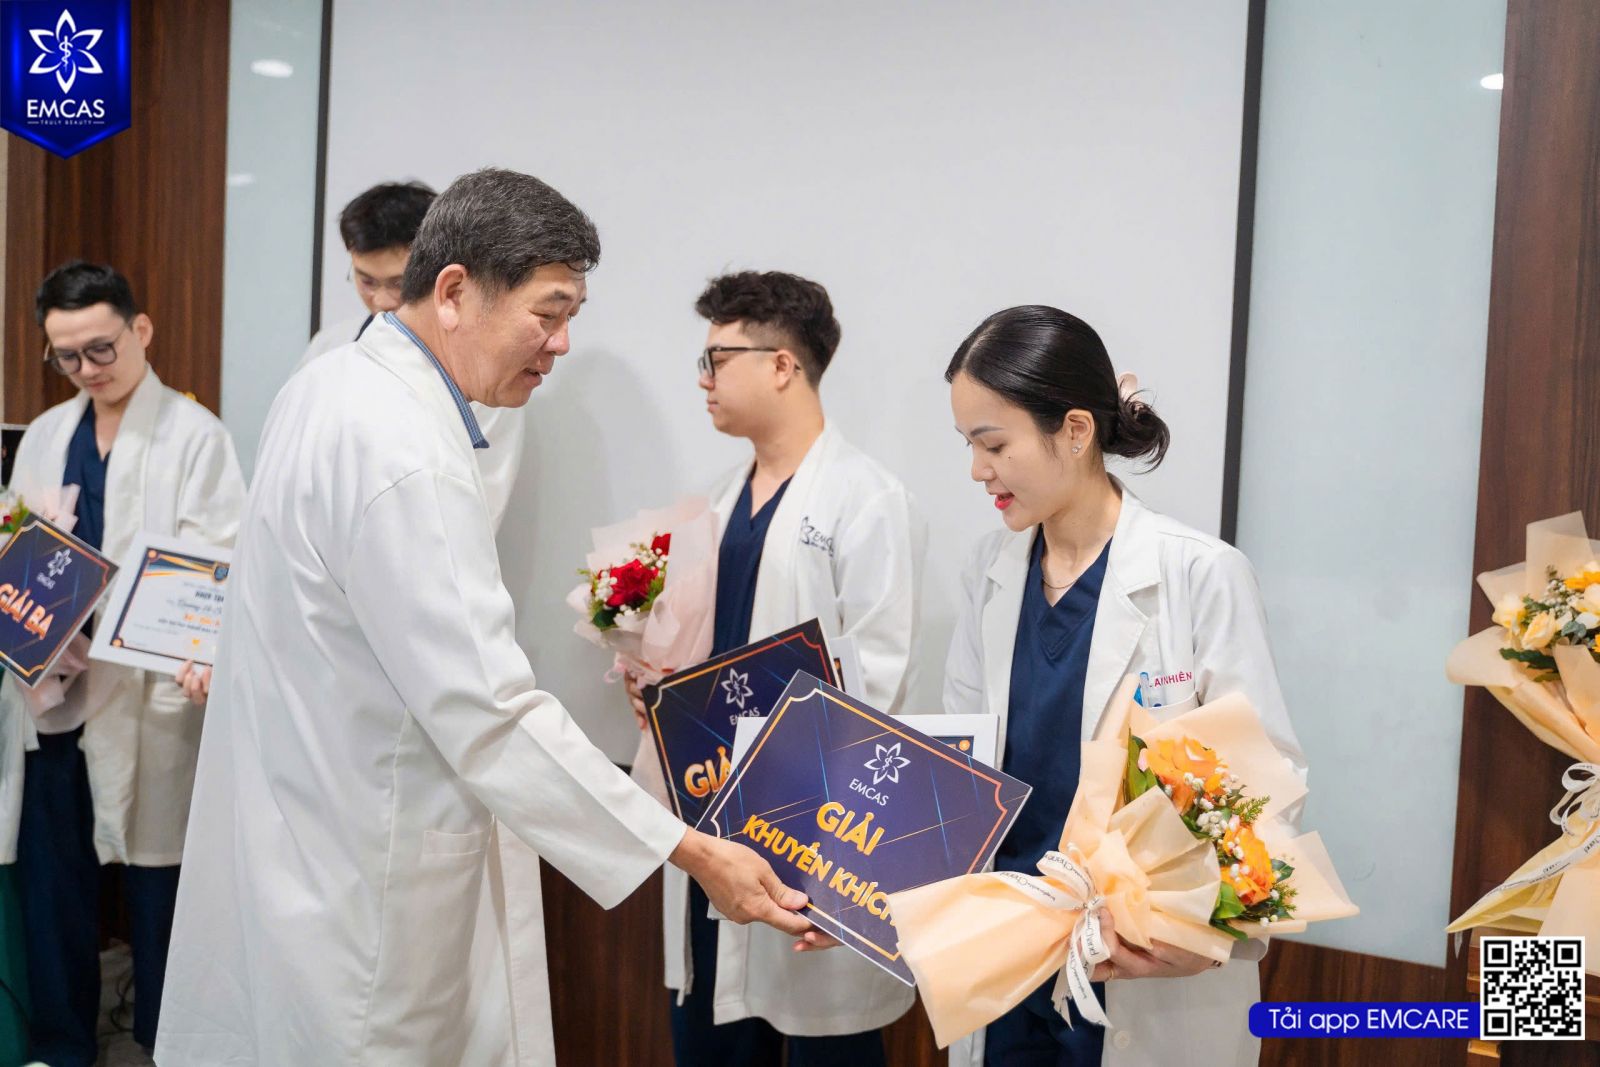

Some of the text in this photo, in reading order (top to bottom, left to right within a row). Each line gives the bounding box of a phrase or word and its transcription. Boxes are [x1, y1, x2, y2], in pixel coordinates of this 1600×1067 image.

[24, 604, 55, 641] BA
[684, 746, 732, 798] GIẢ
[848, 778, 889, 806] EMCAS
[742, 814, 834, 882] KHUYẾN
[816, 801, 885, 856] GIẢI
